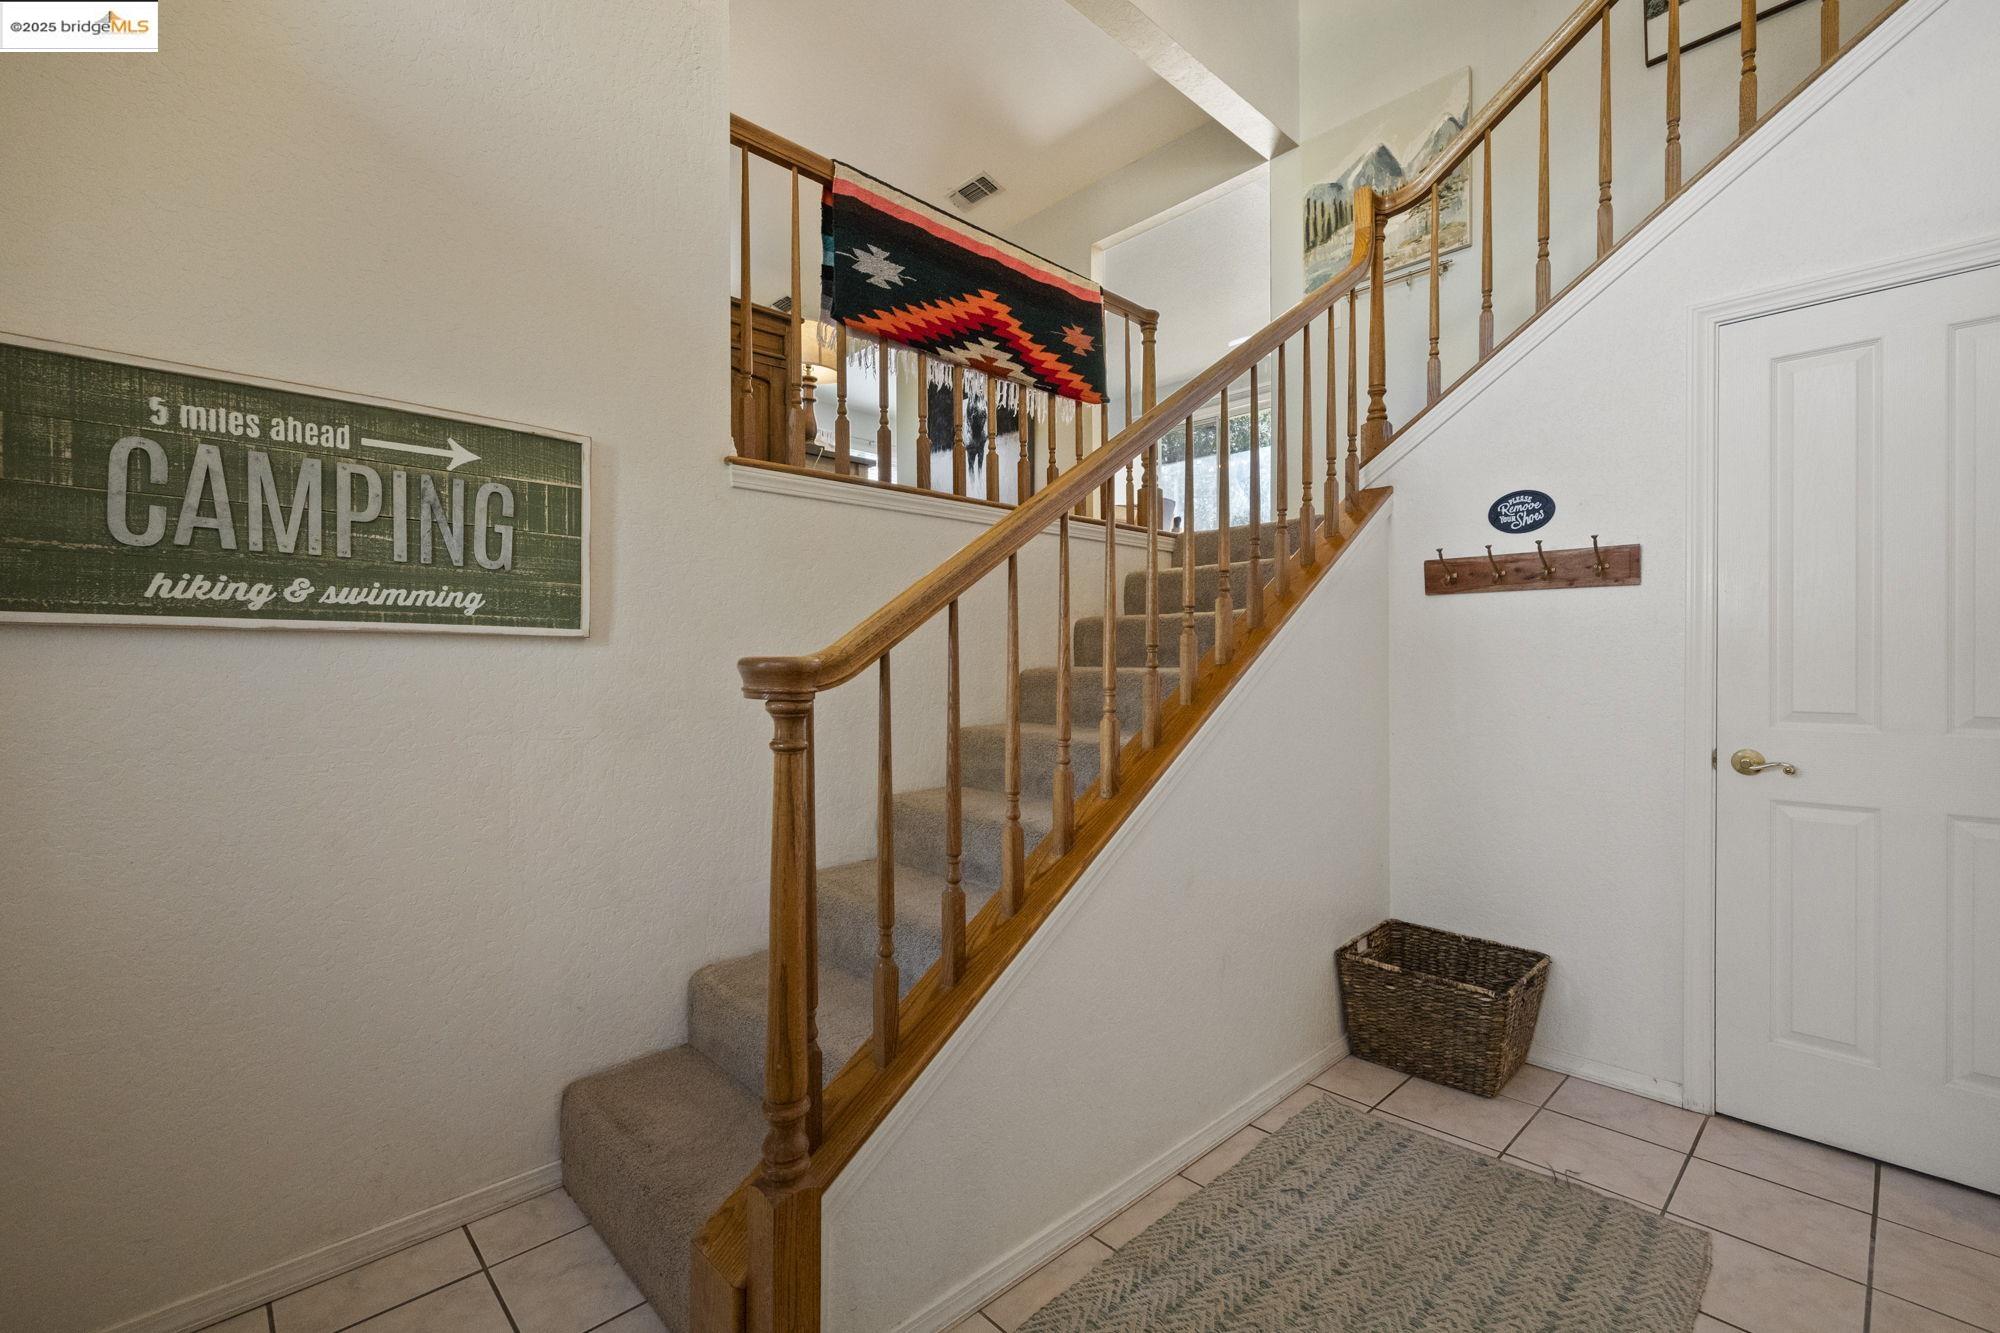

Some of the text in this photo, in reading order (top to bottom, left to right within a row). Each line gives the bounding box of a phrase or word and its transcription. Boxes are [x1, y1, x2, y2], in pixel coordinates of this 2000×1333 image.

[148, 396, 351, 450] 5 miles ahead
[106, 435, 515, 571] CAMPING
[1508, 495, 1533, 506] PLEASE
[1511, 509, 1544, 530] Shoes
[144, 572, 486, 616] hiking & swimming
